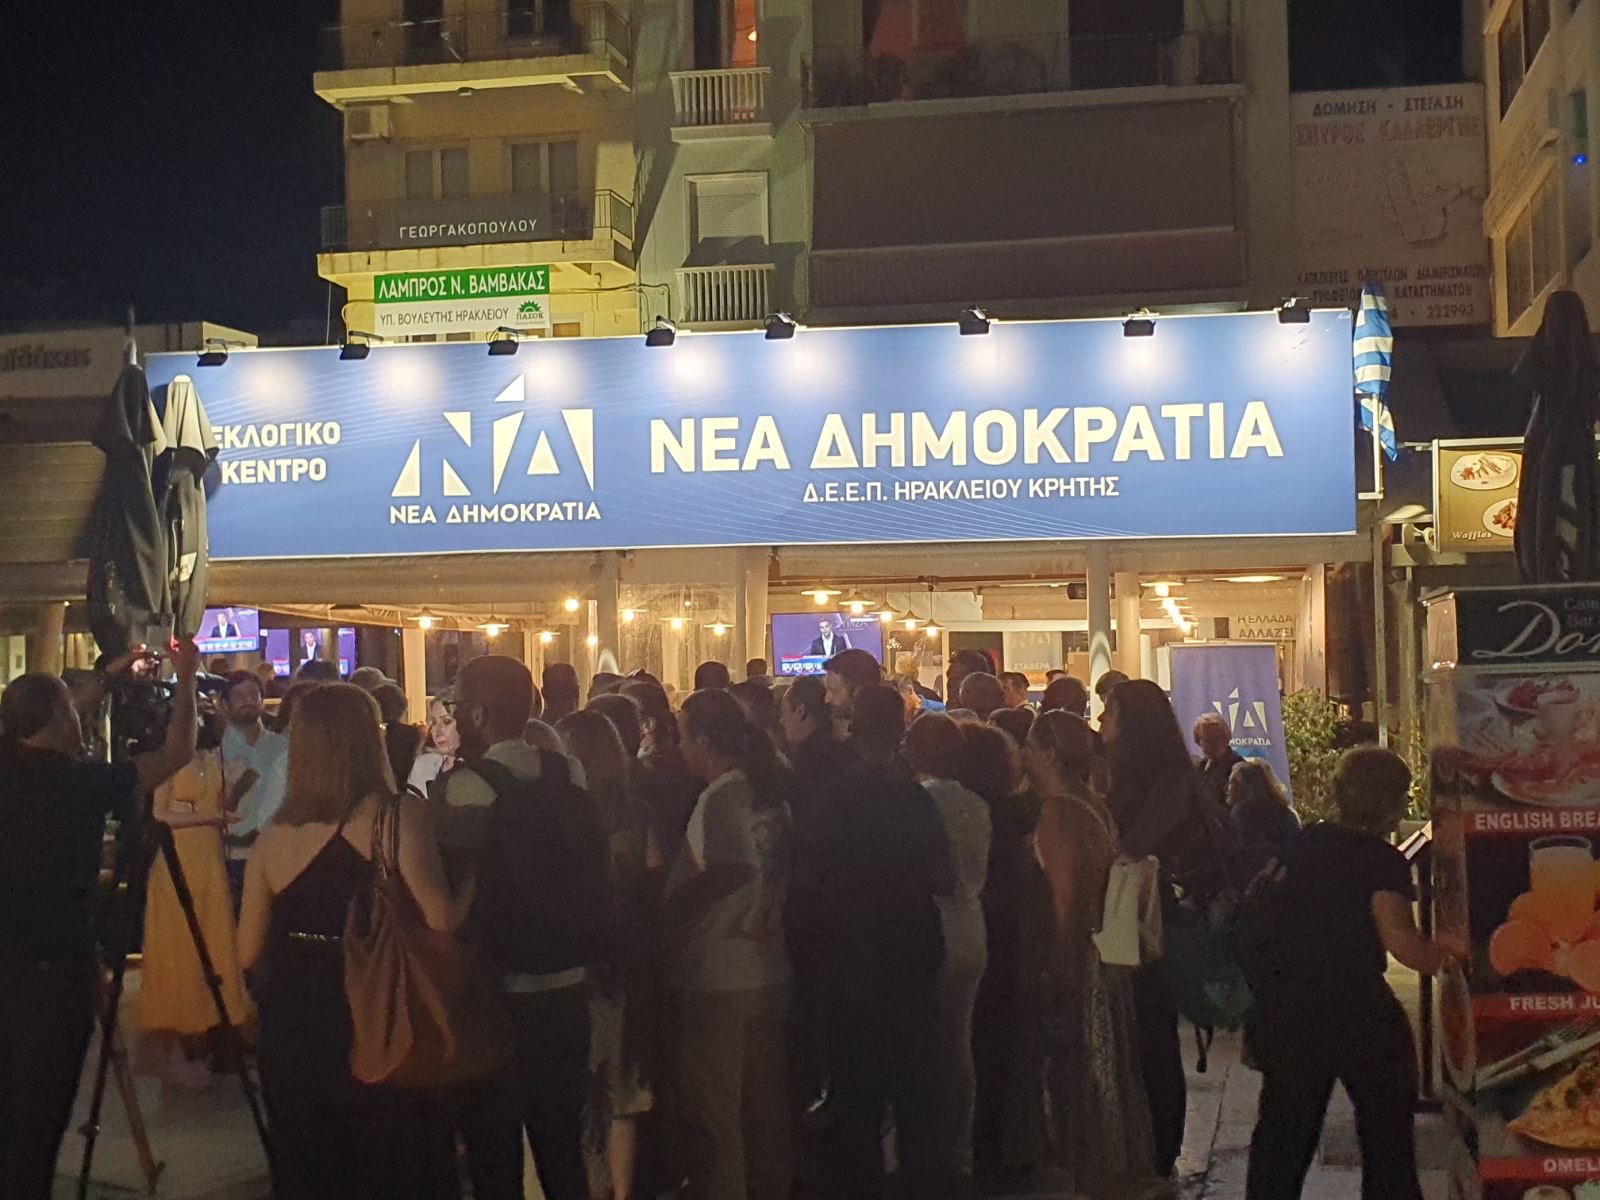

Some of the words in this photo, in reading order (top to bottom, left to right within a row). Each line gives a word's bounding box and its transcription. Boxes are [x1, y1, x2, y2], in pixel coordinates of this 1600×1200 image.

[1312, 100, 1377, 117] ΔΟΜΗΣΗ
[399, 218, 538, 239] ΓΕΩΡΓΑΚΟΠΟΥΛΟΥ
[378, 276, 448, 300] ΛΑΜΠΡΟΣ
[450, 275, 465, 295] Ν.
[469, 270, 546, 294] ΒΑΜΒΑΚΑΣ
[379, 314, 396, 326] ΥΠ.
[398, 311, 453, 326] ΒΟΥΛΕΥΤΗΣ
[455, 307, 509, 322] ΗΡΑΚΛΕΙΟΥ
[516, 312, 544, 320] ΠΑΣΟΚ
[650, 414, 792, 474] ΝΕΑ
[809, 400, 1285, 470] ΔΗΜΟΚΡΑΤΙΑ
[221, 456, 328, 485] ΚΕΝΤΡΟ
[802, 480, 889, 504] Δ.Ε.Ε.Π.
[894, 478, 1024, 501] ΗΡΑΚΛΕΙΟΥ
[1028, 475, 1120, 498] ΚΡΗΤΗΣ
[389, 504, 438, 525] ΝΕΑ
[445, 500, 603, 524] ΔΗΜΟΚΡΑΤΙΑ
[1452, 529, 1493, 541] Waffles
[1248, 614, 1293, 625] ΕΛΛΑΔΑ
[1475, 811, 1554, 831] ENGLISH
[1509, 995, 1574, 1011] FRESH
[1543, 1157, 1600, 1173] OMEL
